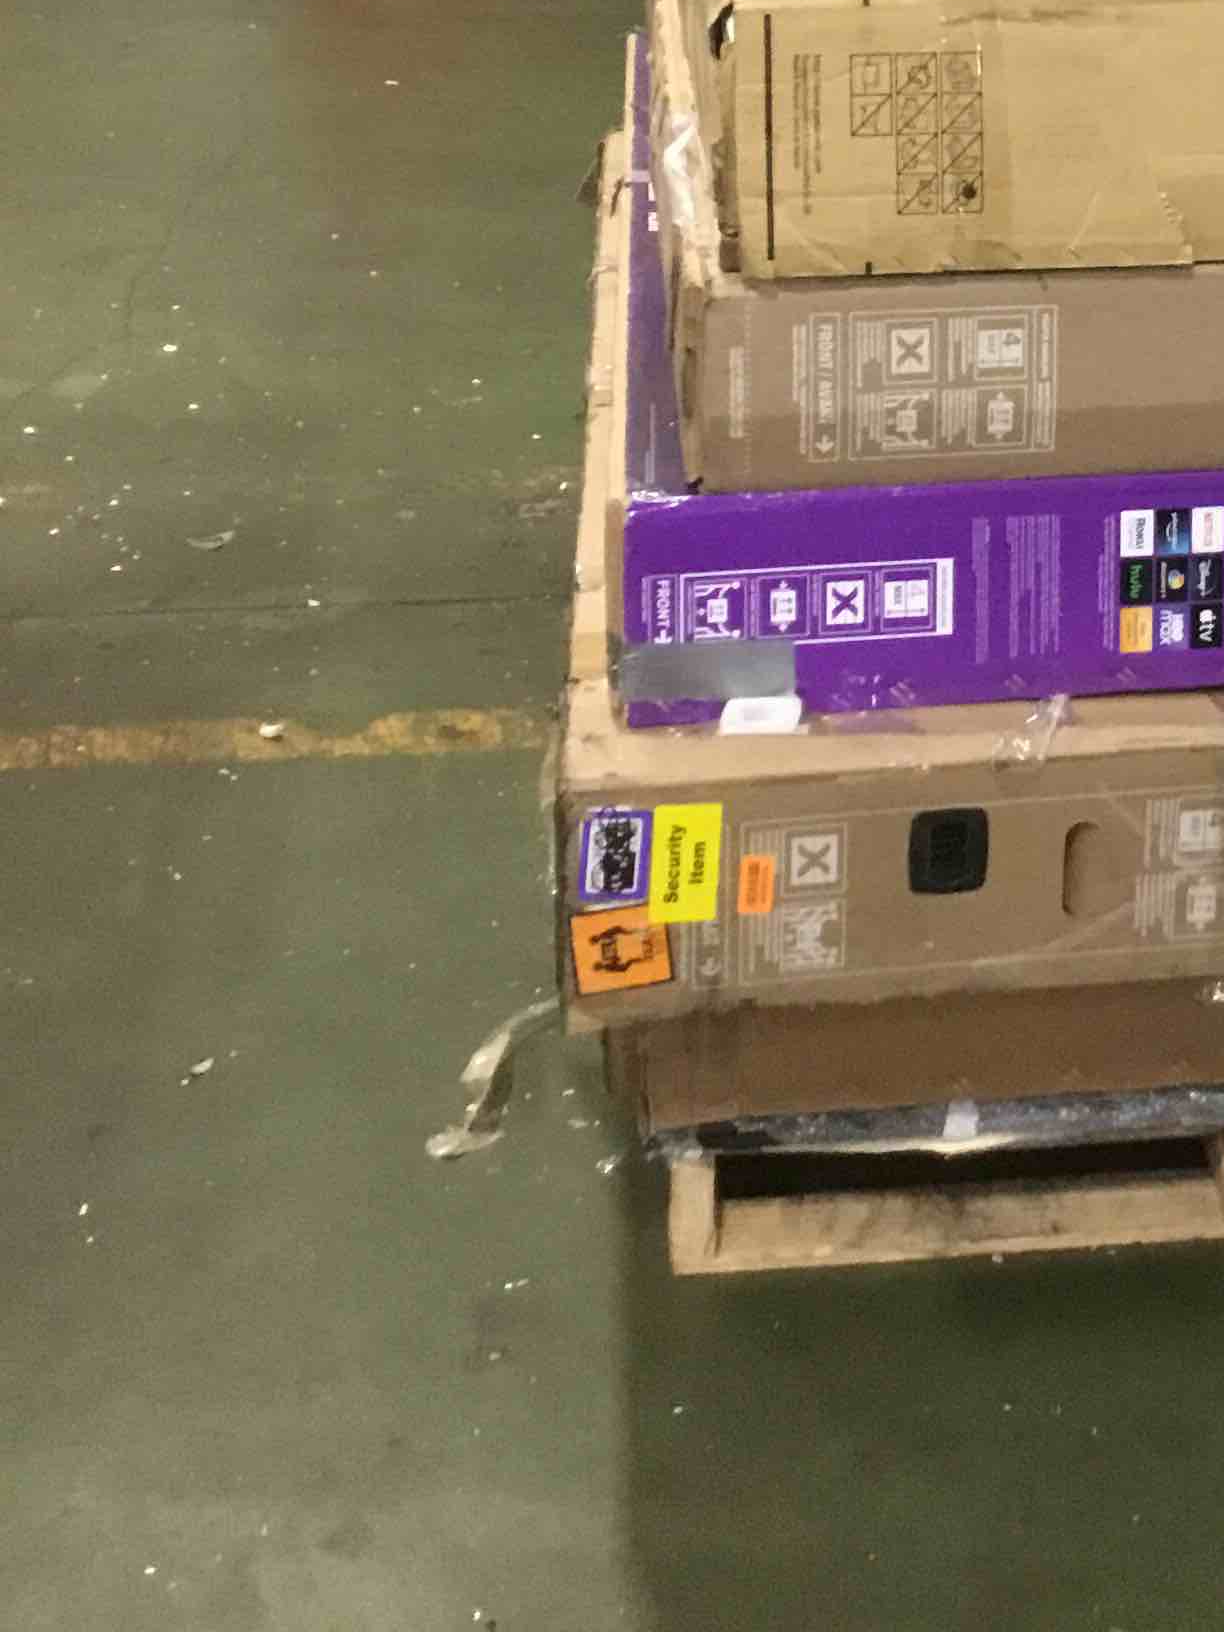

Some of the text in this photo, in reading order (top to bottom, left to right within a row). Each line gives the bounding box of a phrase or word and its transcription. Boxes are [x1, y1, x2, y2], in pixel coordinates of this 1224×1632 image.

[656, 578, 672, 628] FRONT
[1129, 563, 1143, 599] hulu
[662, 824, 686, 904] Security
[688, 841, 706, 885] Item
